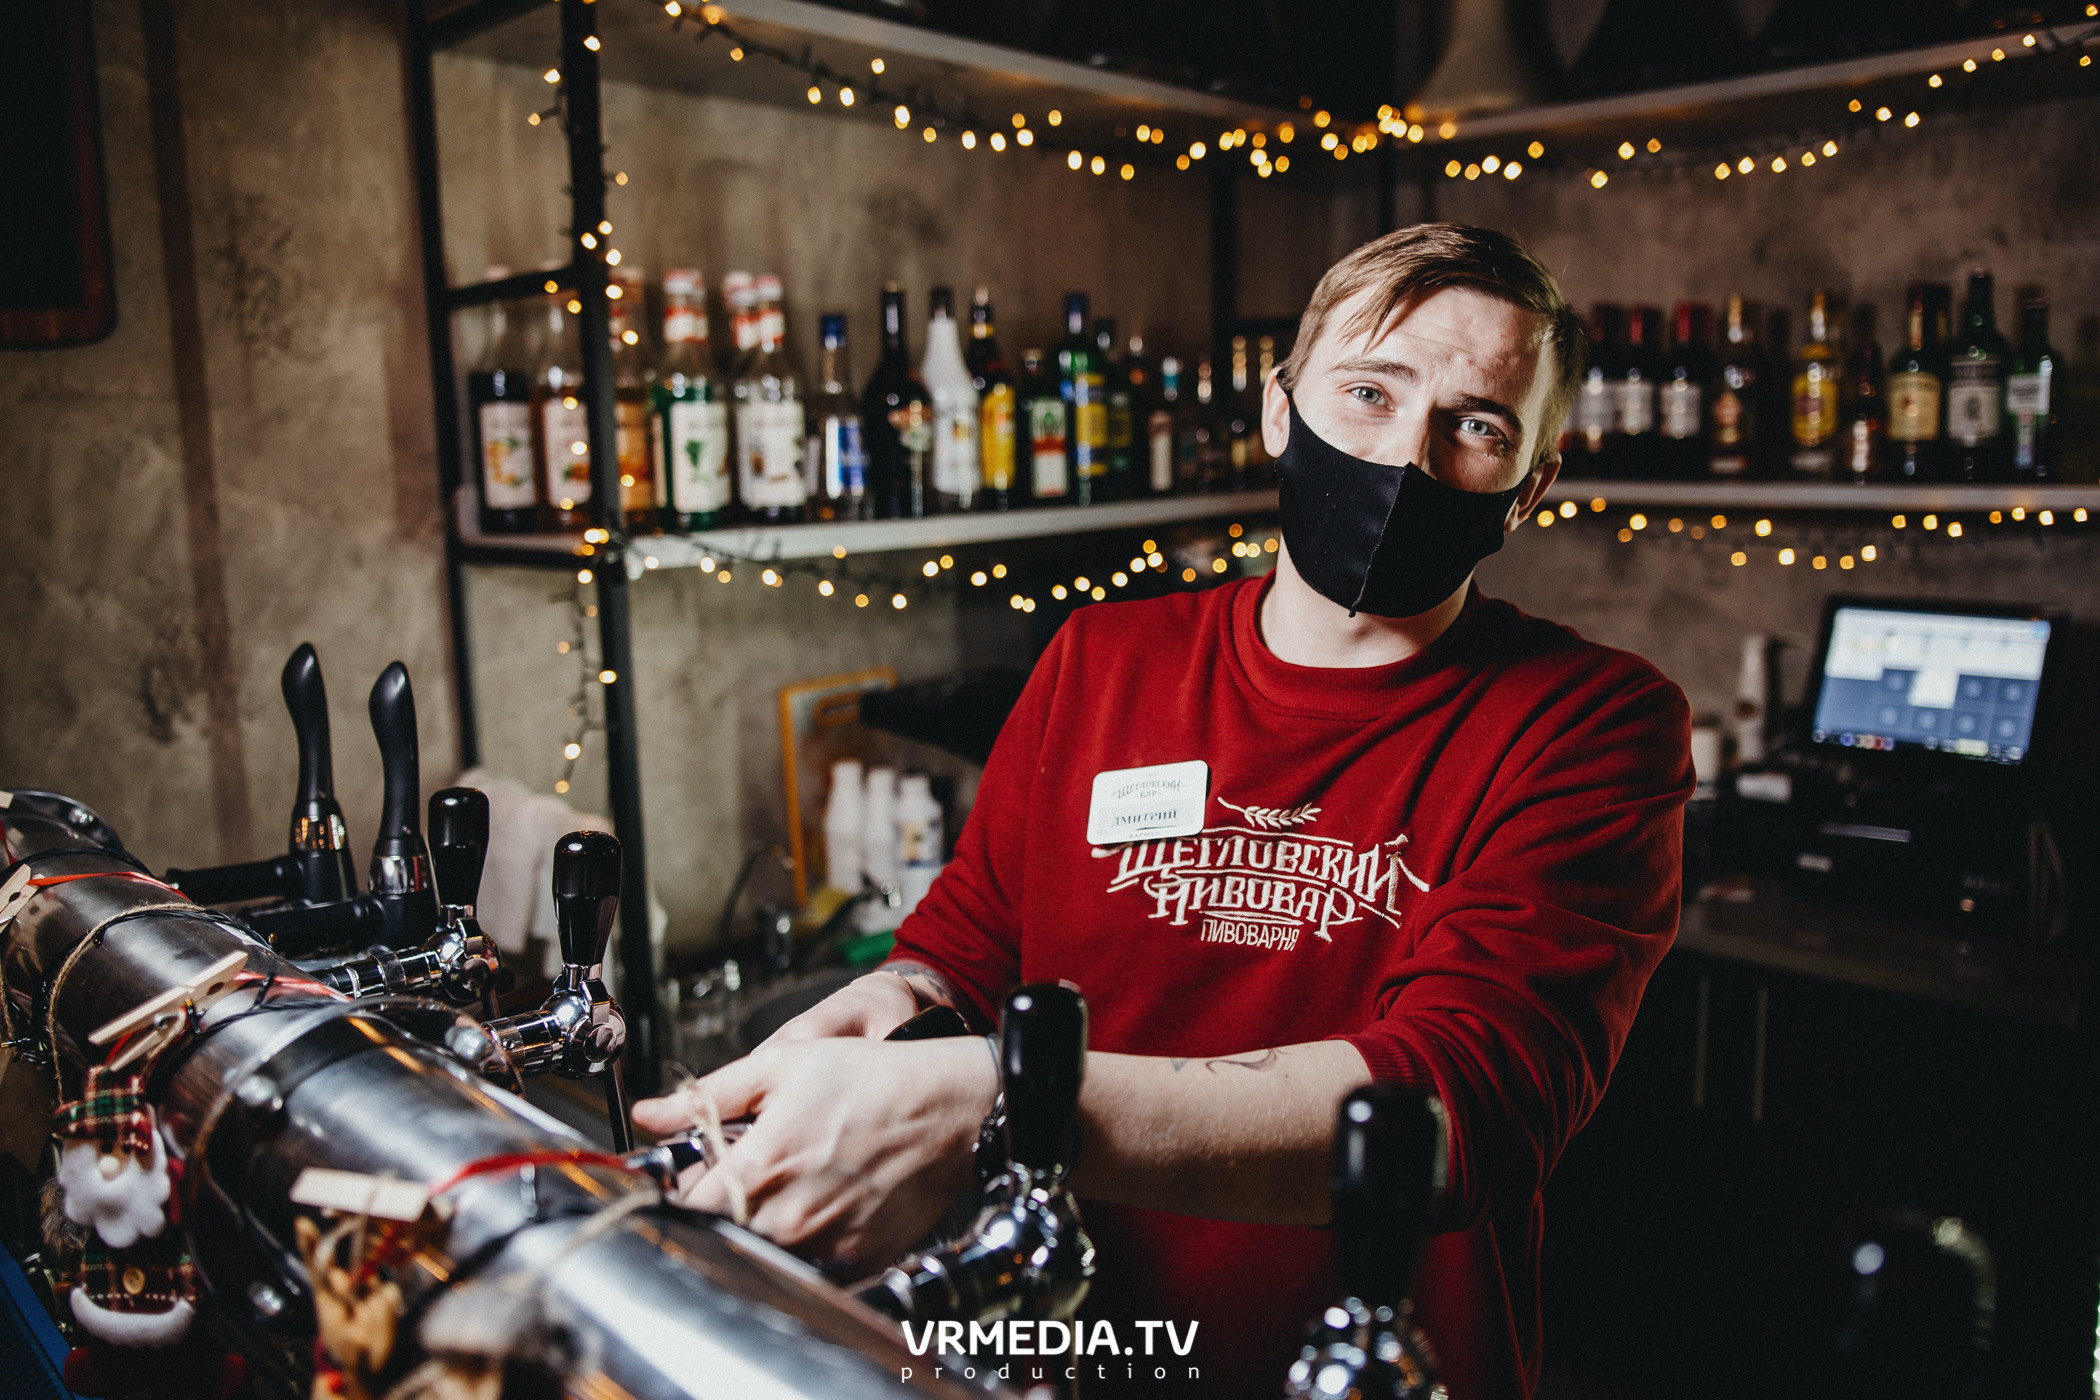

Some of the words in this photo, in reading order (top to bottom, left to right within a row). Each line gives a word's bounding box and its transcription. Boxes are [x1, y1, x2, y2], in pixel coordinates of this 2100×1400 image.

[1112, 809, 1178, 828] ДМИТРИЙ
[1091, 834, 1430, 916] ЩЕГЛОВСКИЙ
[1143, 868, 1364, 943] ПИВОВАР
[1200, 919, 1300, 951] ПИВОВАРНЯ
